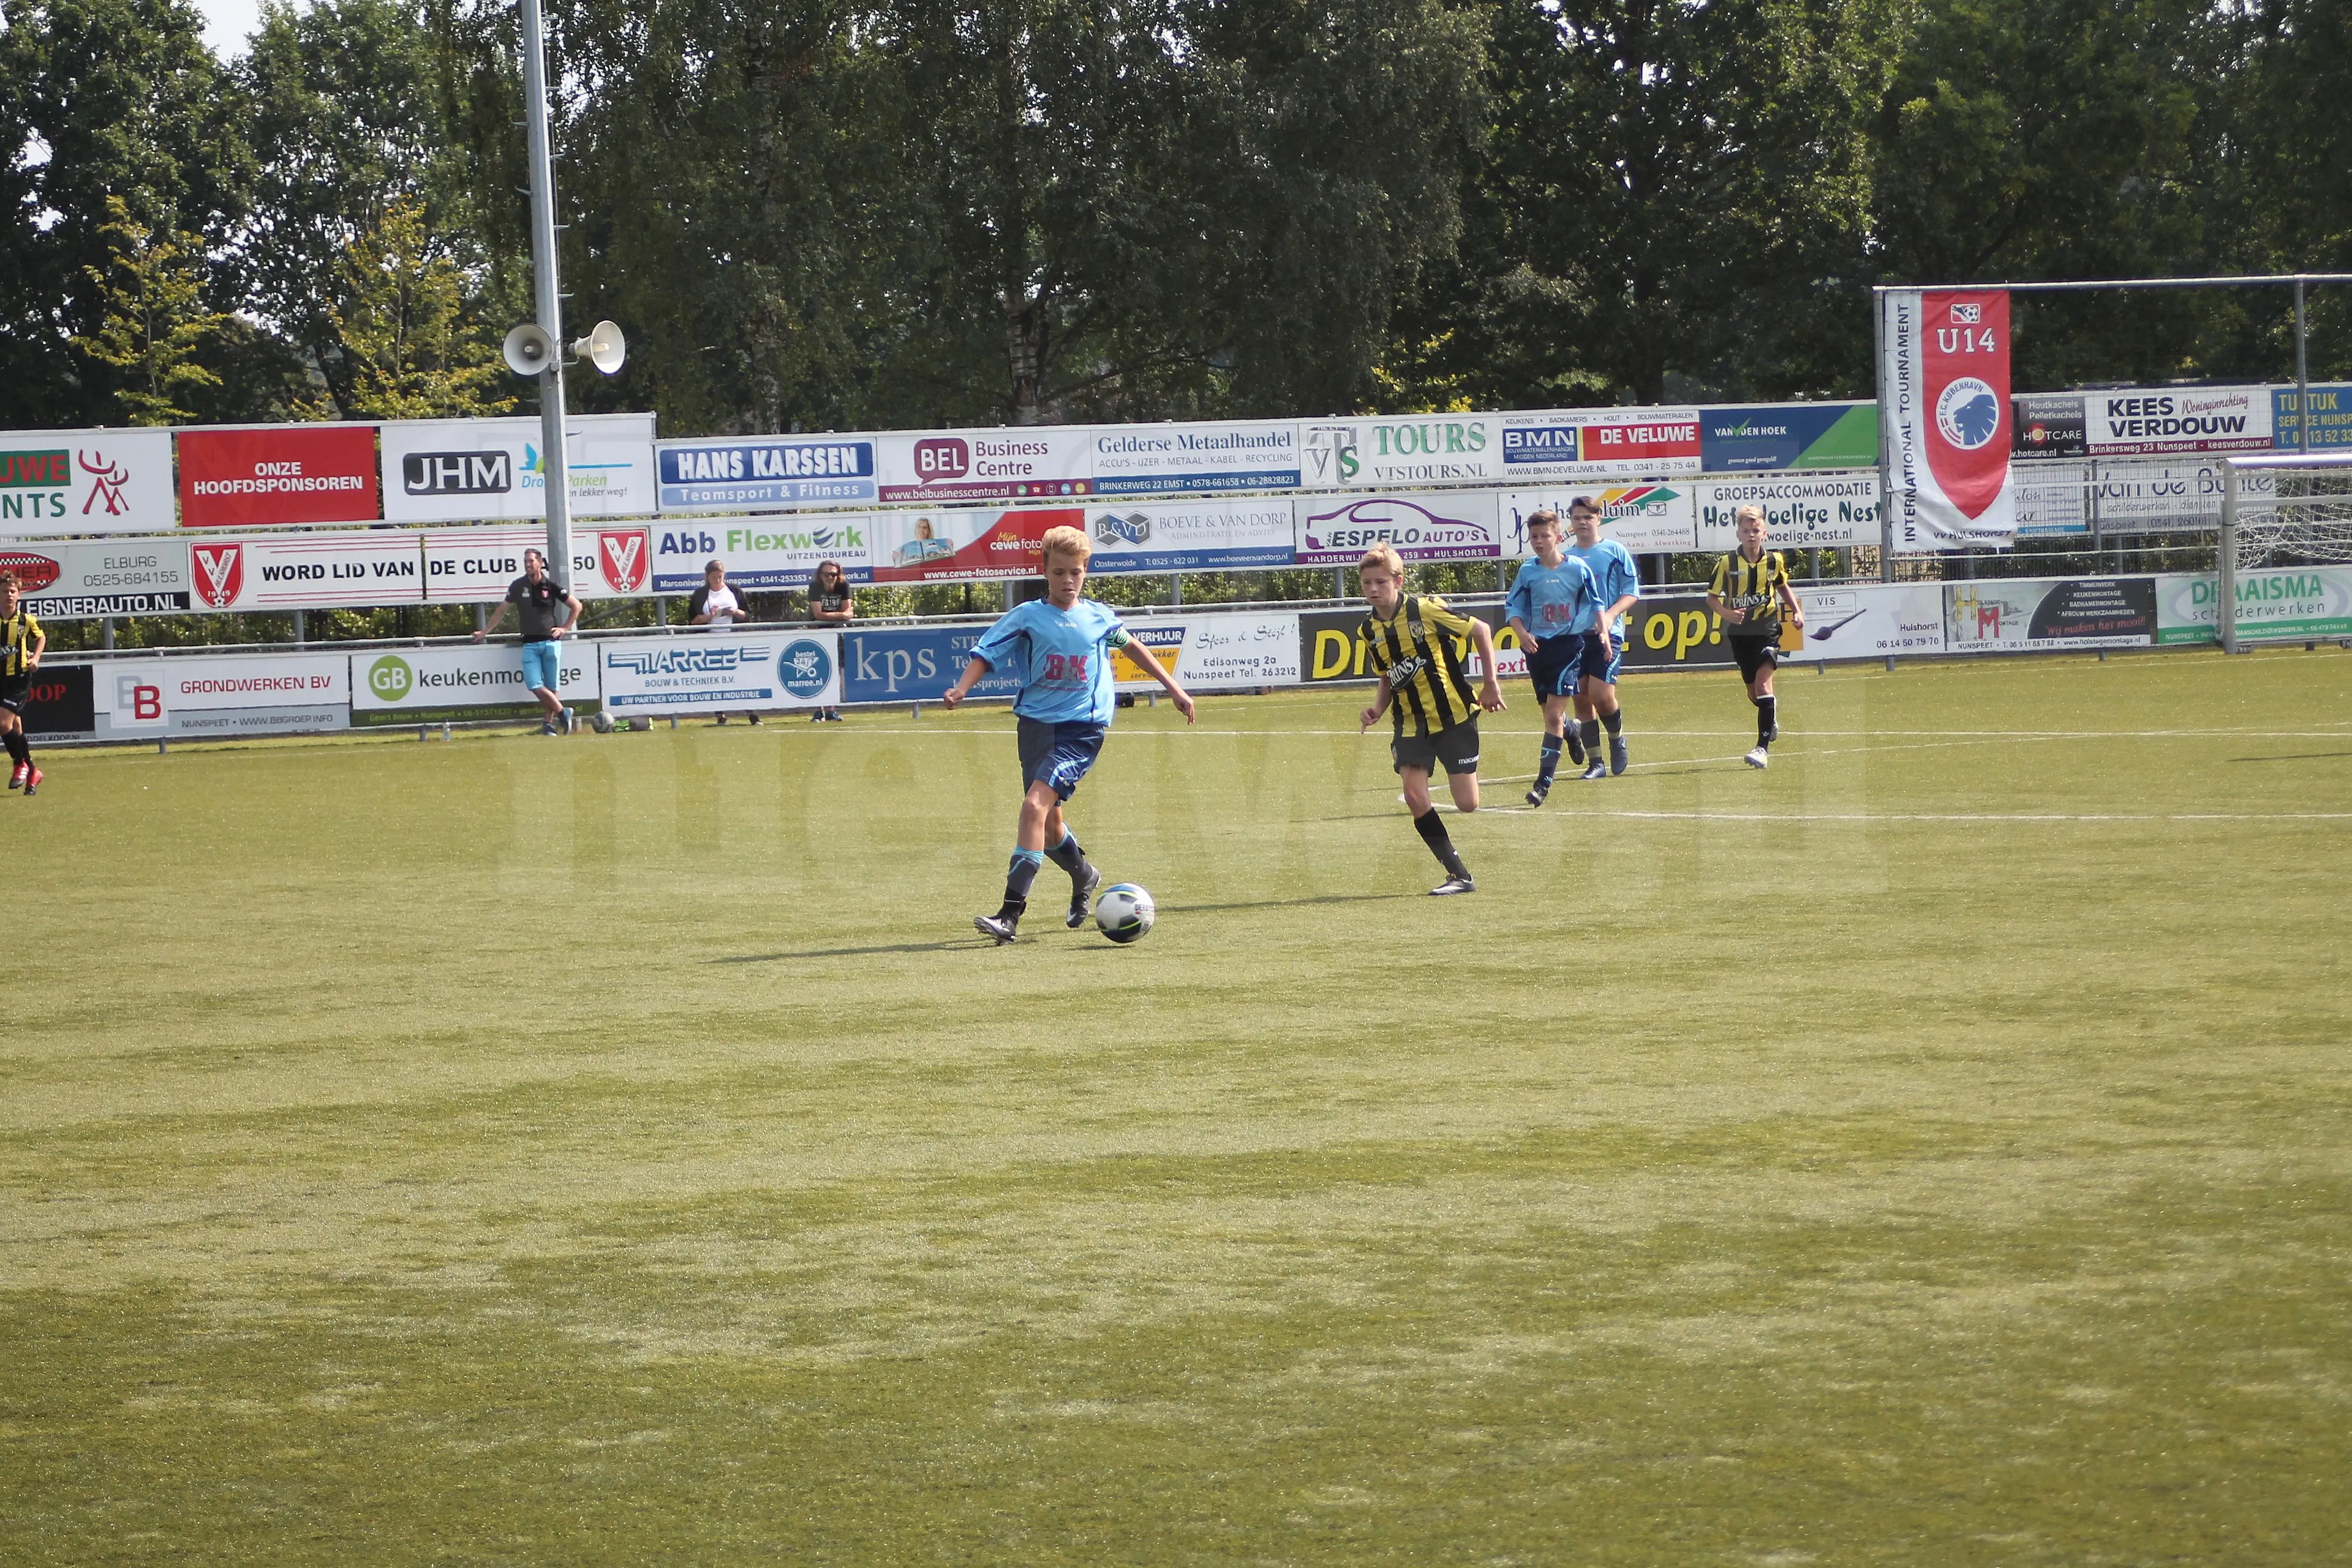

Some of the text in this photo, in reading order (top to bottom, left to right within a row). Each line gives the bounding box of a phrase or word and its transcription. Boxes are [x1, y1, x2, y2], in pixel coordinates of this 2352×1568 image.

[1937, 328, 1995, 353] U14
[2029, 401, 2079, 410] Houtkachels
[2107, 392, 2248, 417] KEES Woninginrichting
[2029, 410, 2082, 419] Pelletkachels
[1898, 304, 1917, 542] INTERNATIONAL TOURNAMENT
[2108, 416, 2246, 437] VERDOUW
[1372, 422, 1487, 455] TOURS
[1505, 430, 1575, 447] BMN
[1600, 426, 1695, 444] DE VELUWE
[1715, 426, 1787, 437] VAN DEN HOEK
[2023, 429, 2081, 441] HOTCARE
[2325, 430, 2338, 442] 52
[976, 439, 1048, 456] Business
[1098, 431, 1292, 453] Gelderse Metaalhandel
[2089, 443, 2139, 454] Brinkersweg
[2157, 439, 2197, 453] Nunspeet
[2207, 438, 2271, 449] keesverdouw.nl
[677, 447, 859, 480] HANS KARSSEN
[920, 447, 965, 472] BEL
[1099, 458, 1130, 468] ACCU'S
[1167, 456, 1203, 466] METAAL
[1210, 454, 1238, 464] KABEL
[1245, 453, 1292, 463] RECYCLING
[255, 461, 302, 477] ONZE
[407, 456, 508, 490] JHM
[976, 460, 1032, 476] Centre
[1374, 462, 1487, 480] VTSTOURS.NL
[1507, 464, 1607, 475] WWW.BMN-DEVELUWE.NL
[194, 475, 363, 495] HOOFDSPONSOREN
[1099, 475, 1295, 491] BRINKERWEG 22 EMST 0578-661658 06-28828823
[579, 486, 628, 498] lekker weg!
[680, 483, 860, 502] Teamsport & Fitness
[885, 485, 1010, 500] www.belbusinesscentre.nl
[1714, 482, 1872, 501] GROEPSACCOMMODATIE
[1159, 512, 1286, 529] BOEVE & VAN DORP
[659, 530, 716, 556] Abb
[1332, 528, 1480, 548] ESPELO AUTO'S
[1949, 530, 2013, 540] HULSHORST
[990, 540, 1020, 551] cewe
[1433, 549, 1489, 558] HULSHORST
[104, 555, 157, 569] ELBURG
[786, 550, 867, 560] UITZENDBUREAU
[1095, 558, 1137, 568] Oosterwolde
[1174, 557, 1186, 565] 622
[1208, 552, 1288, 564] www.boeveenvandorp.nl
[262, 561, 414, 581] WORD LID VAN
[430, 560, 456, 575] DE
[463, 558, 517, 574] CLUB
[923, 565, 1037, 579] www.cewe-fotoservice.nl
[83, 570, 178, 587] 0525-684155
[760, 574, 807, 583] 0341-253353
[1733, 593, 1761, 609] PRINS
[1817, 597, 1836, 606] VIS
[1644, 597, 1722, 660] op!
[1899, 622, 1939, 633] Hulshorst
[1877, 637, 1939, 649] 06 14 50 79 70
[796, 658, 815, 667] 24/7
[854, 637, 937, 693] kps
[1203, 656, 1276, 668] Edisonweg 2a
[373, 667, 407, 690] GB
[645, 676, 735, 687] BOUW & TECHNIEK B.V.
[1183, 669, 1235, 680] Nunspeet
[1262, 668, 1296, 677] 263212
[181, 676, 331, 694] GRONDWERKEN BV
[788, 678, 824, 688] marree.nl
[622, 690, 760, 705] UW PARTNER VOOR BOUW EN INDUSTRIE
[181, 714, 333, 728] NUNSPEET WWW.BBGROEP.INFO
